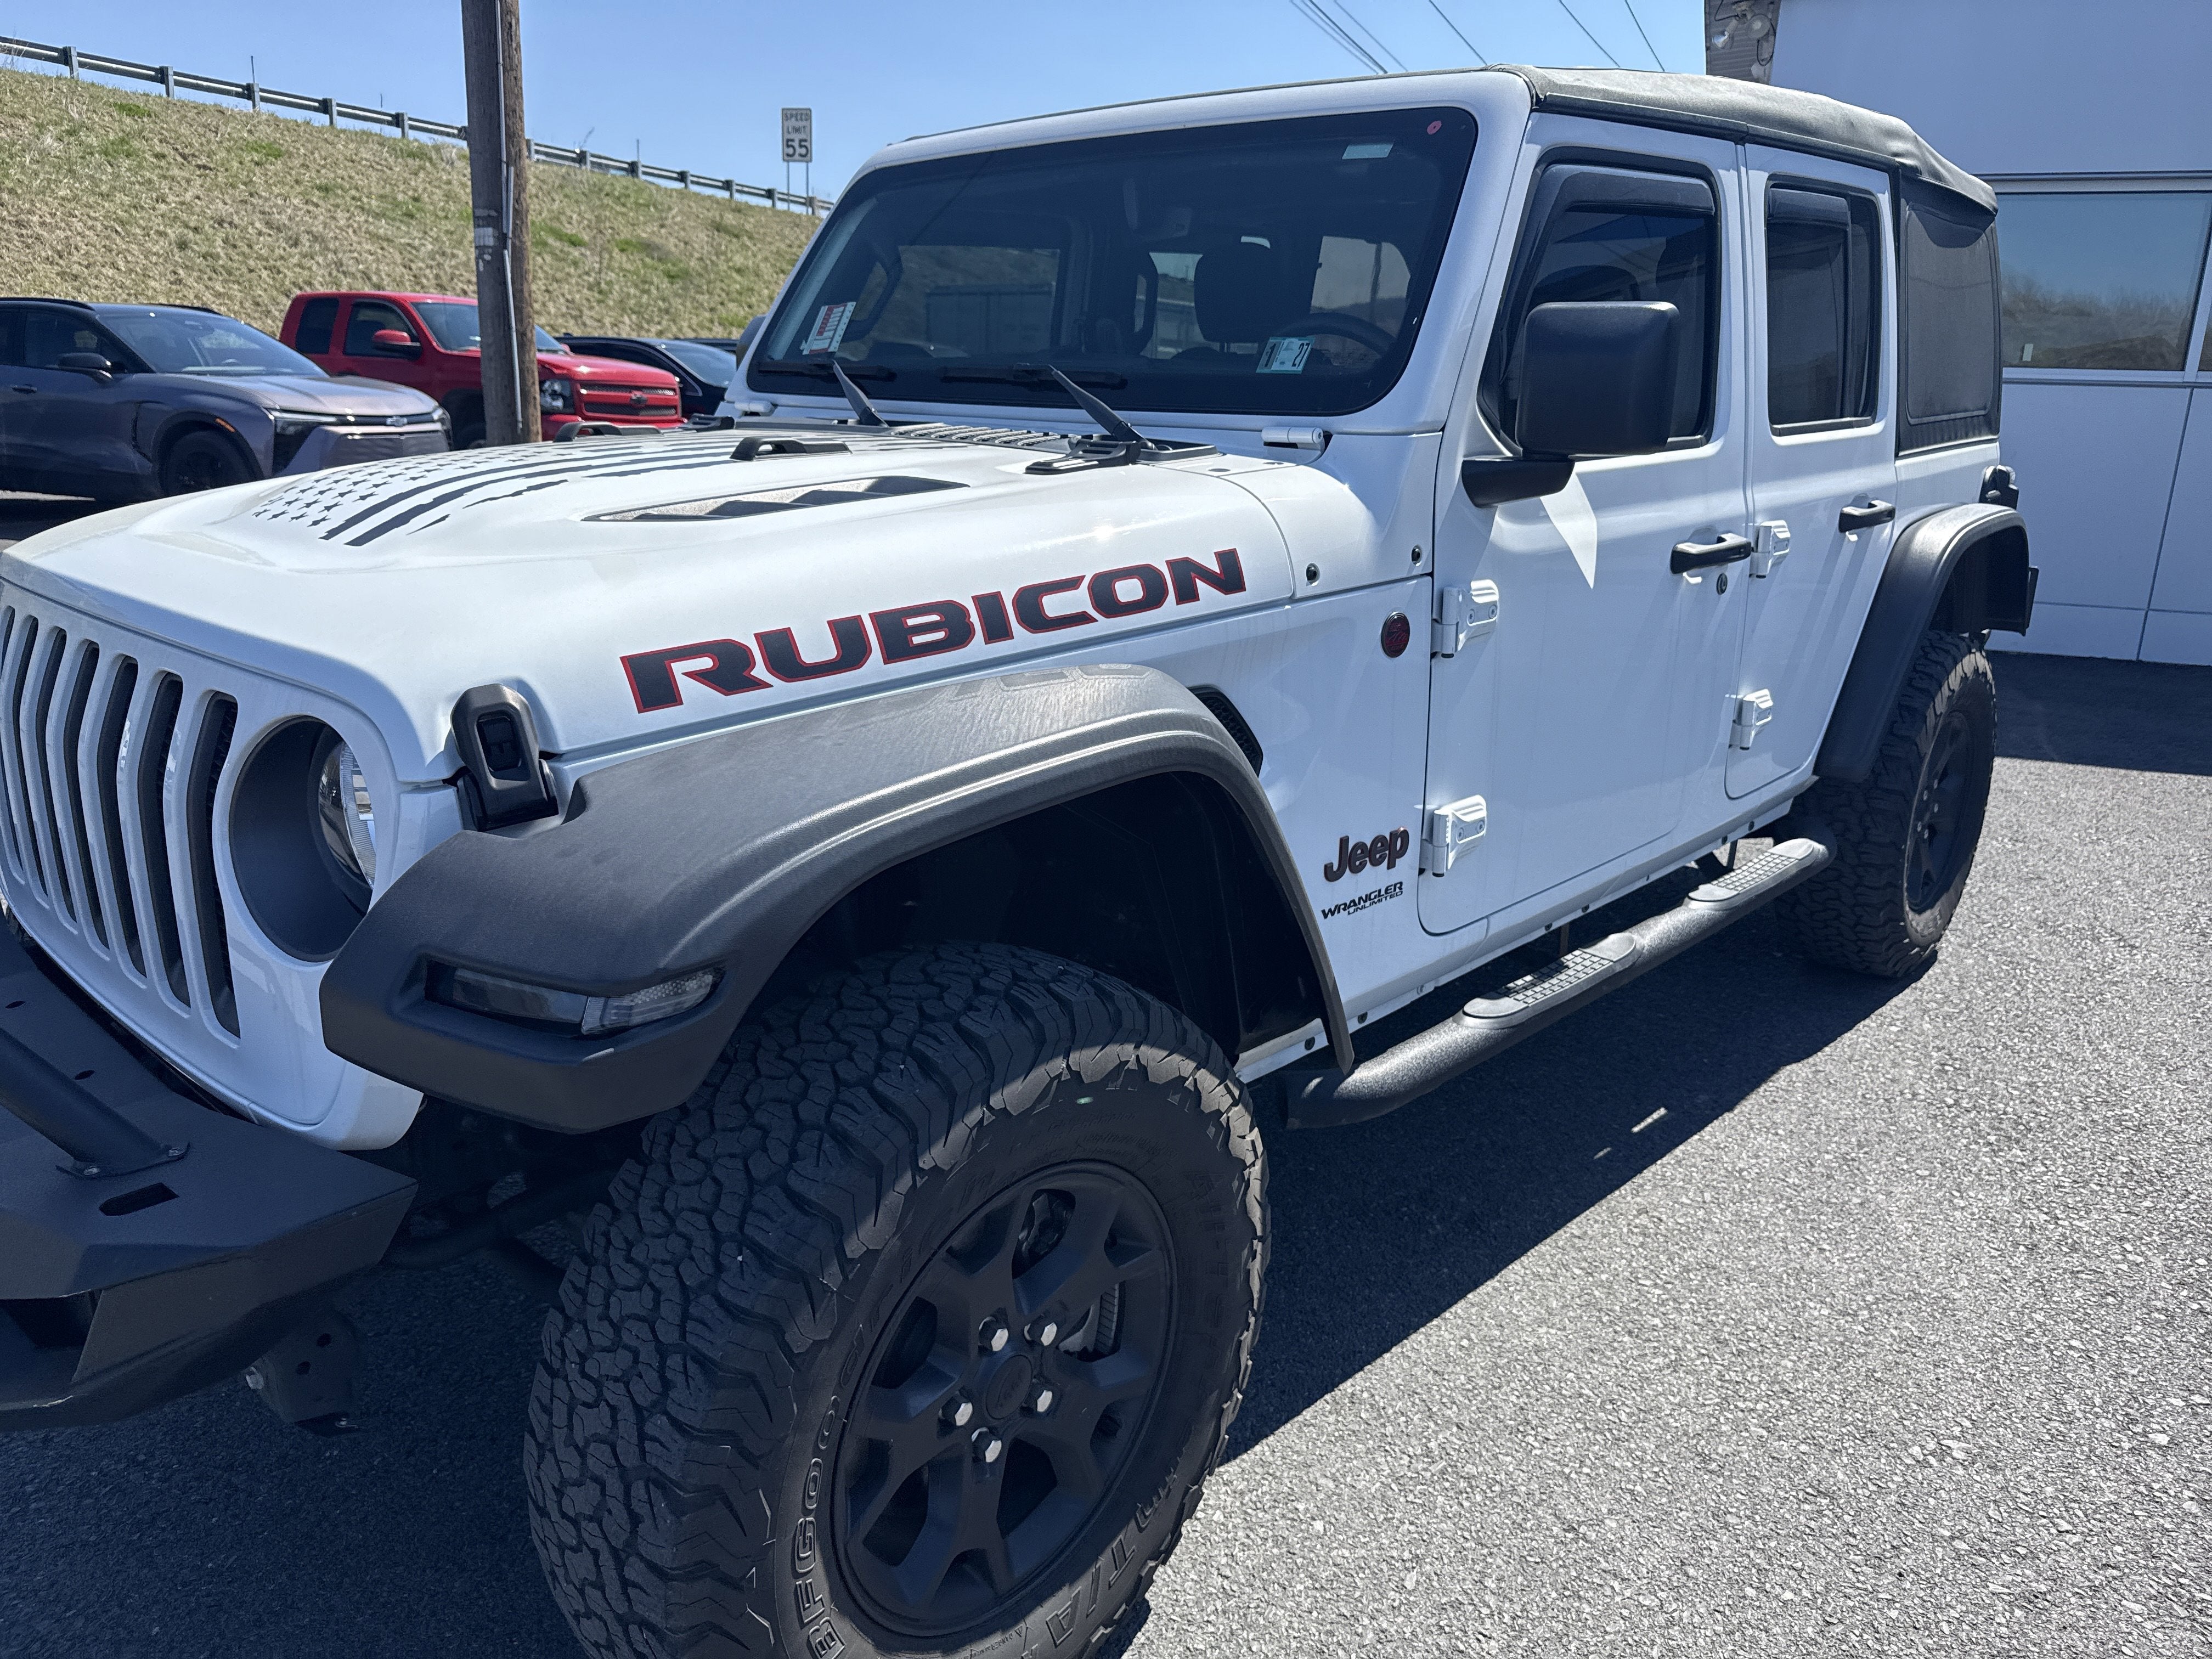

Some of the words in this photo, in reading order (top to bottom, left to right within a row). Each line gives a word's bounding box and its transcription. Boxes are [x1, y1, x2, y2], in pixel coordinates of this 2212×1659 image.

[785, 112, 809, 121] SPEED
[787, 126, 807, 134] LIMIT
[786, 138, 809, 157] 55
[1291, 342, 1311, 368] 27
[620, 548, 1246, 714] RUBICON
[1324, 827, 1409, 882] Jeep
[1321, 881, 1403, 919] WRANGLER
[1347, 890, 1403, 916] UNLIMITED
